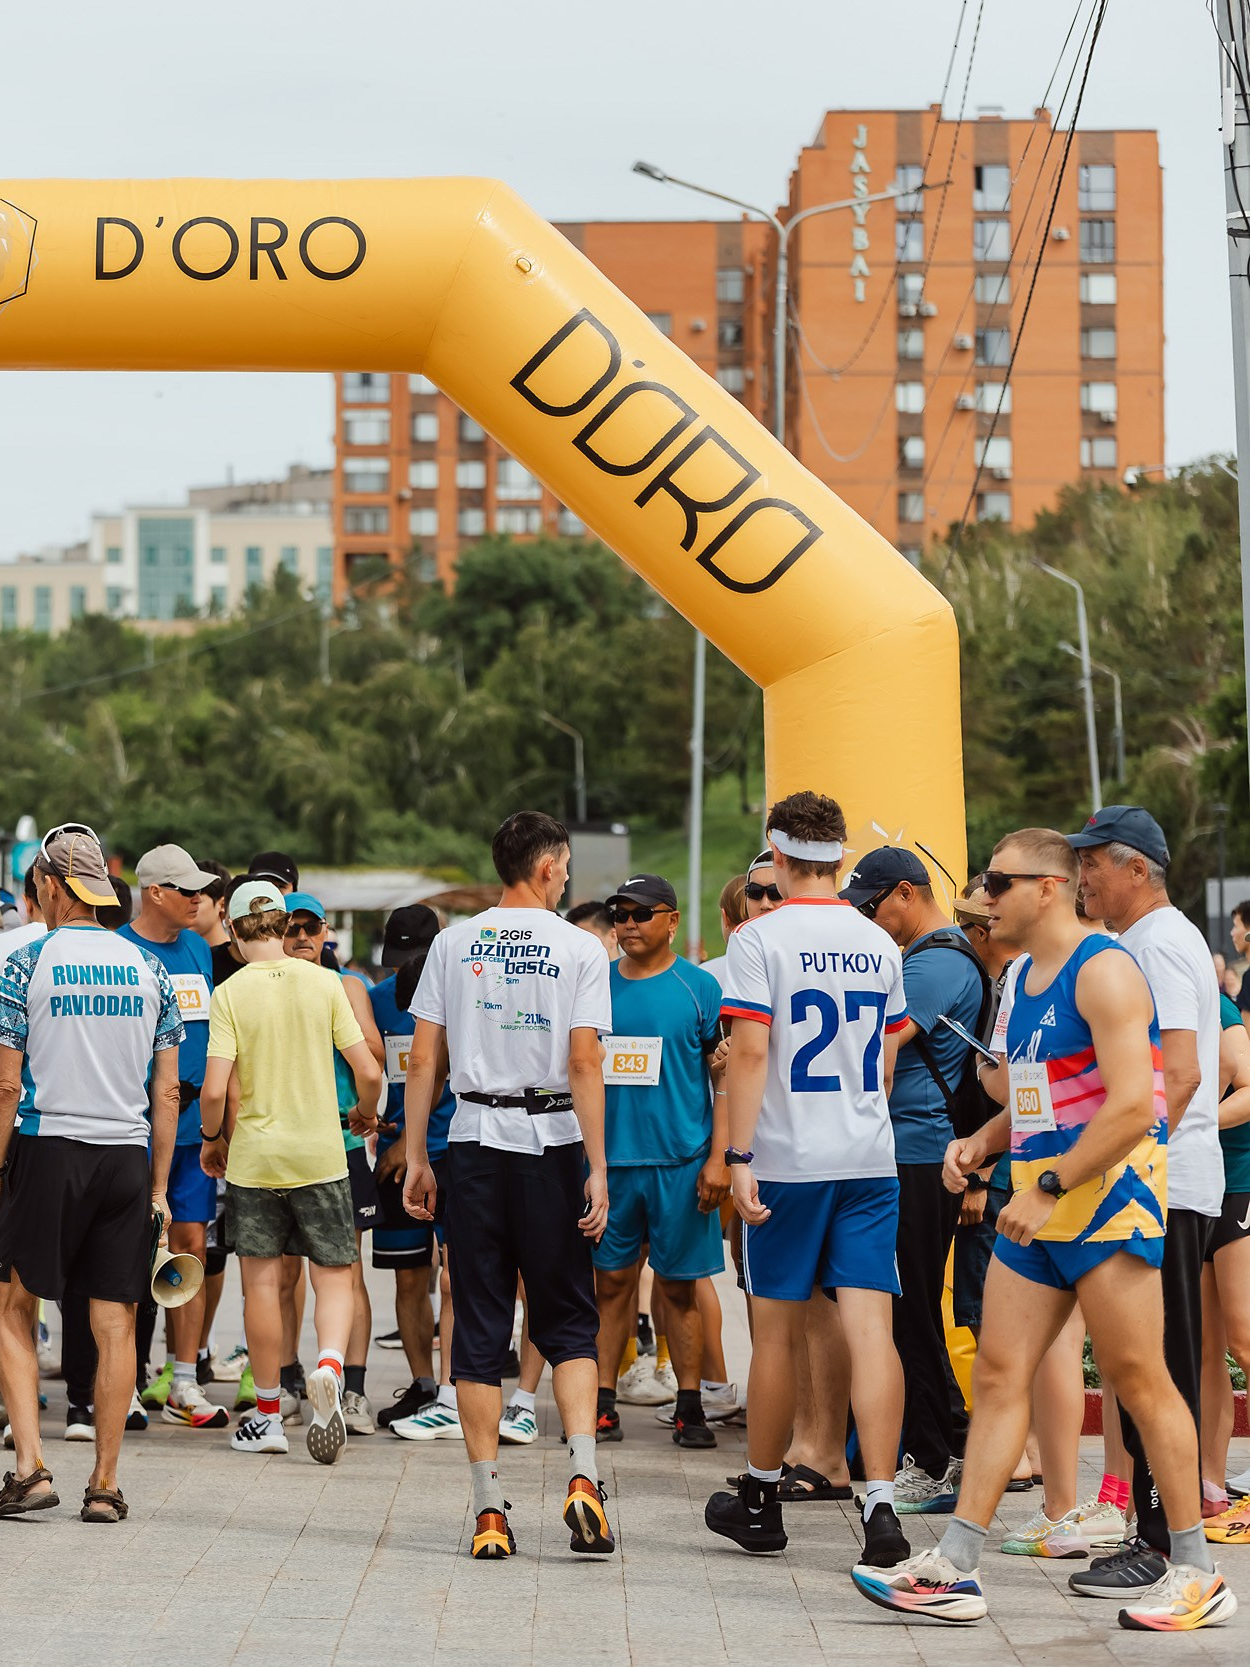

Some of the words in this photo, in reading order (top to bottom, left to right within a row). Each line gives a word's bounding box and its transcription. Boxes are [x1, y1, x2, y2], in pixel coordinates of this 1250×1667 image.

[850, 124, 871, 302] JASYBAI
[500, 929, 533, 940] 2GIS
[504, 958, 560, 979] basta
[800, 952, 882, 973] PUTKOV
[52, 964, 140, 986] RUNNING
[505, 977, 520, 985] 5km
[50, 994, 144, 1018] PAVLODAR
[177, 991, 199, 1008] 94
[483, 1002, 503, 1010] 10km
[790, 988, 889, 1093] 27
[616, 1055, 645, 1072] 343
[1018, 1091, 1038, 1112] 360
